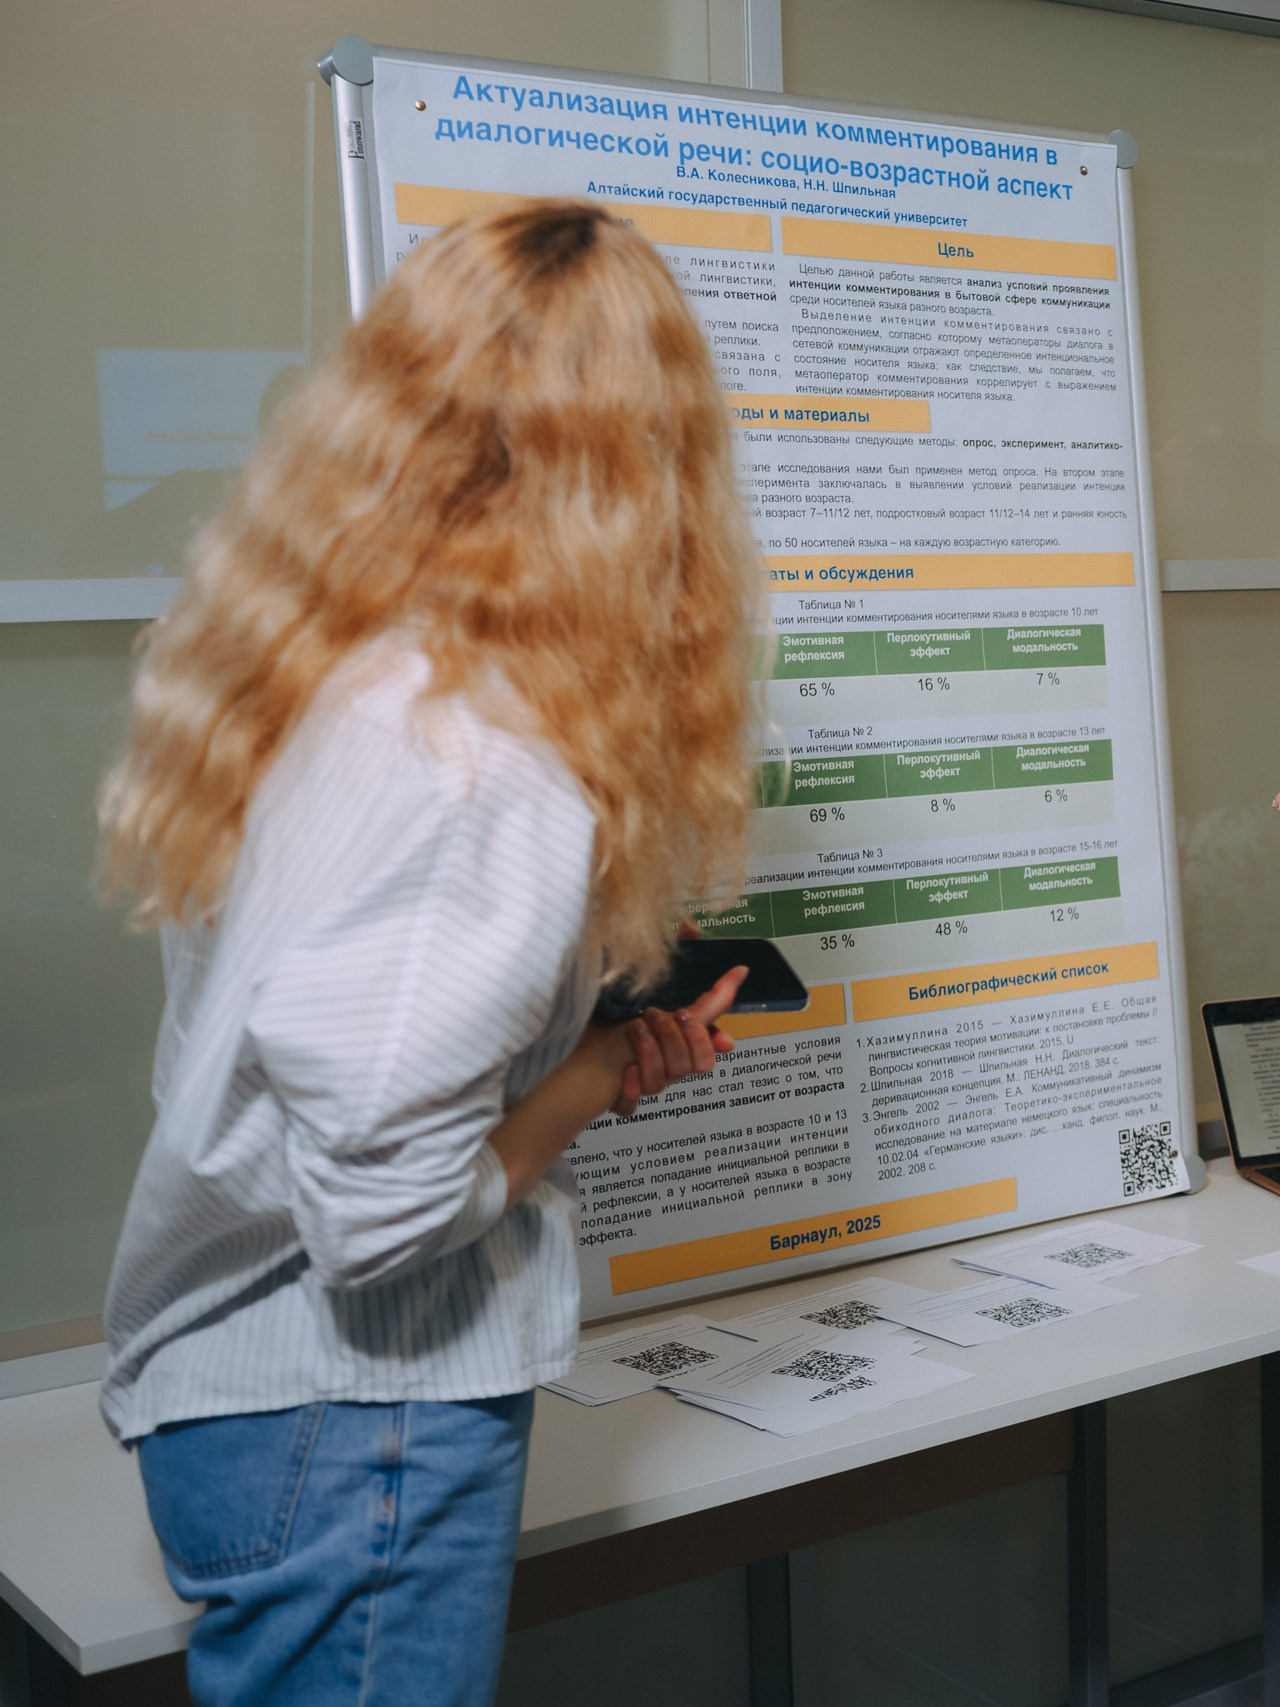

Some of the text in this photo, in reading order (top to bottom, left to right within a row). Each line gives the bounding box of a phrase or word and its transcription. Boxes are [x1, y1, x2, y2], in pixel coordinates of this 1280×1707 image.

[452, 74, 1057, 165] Актуализация интенции комментирования в
[434, 119, 1073, 199] диалогической речи: социо-возрастной аспект
[676, 163, 896, 198] В.А. Колесникова, Н.Н. Шпильная
[586, 181, 967, 226] Алтайский государственный педагогический университет
[937, 242, 974, 258] Цель
[689, 257, 775, 270] лингвистики
[798, 263, 1109, 295] Целью данной работы является анализ условий проявления
[722, 290, 776, 301] ответной
[788, 280, 1110, 308] интенции комментирования в бытовой сфере коммуникации
[788, 294, 820, 305] среди
[822, 297, 876, 308] носителей
[877, 300, 907, 310] языка
[908, 302, 946, 313] разного
[704, 319, 779, 332] путем поиска
[800, 308, 1112, 337] Выделение интенции комментирования связано с
[887, 330, 932, 341] согласно
[937, 333, 982, 345] которому
[987, 336, 1061, 347] метаоператоры
[1066, 340, 1103, 349] диалога
[1107, 342, 1113, 350] в
[773, 353, 781, 362] с
[791, 339, 1114, 363] сетевой коммуникации отражают определенное интенциональное
[792, 354, 846, 365] состояние
[853, 358, 900, 367] носителя
[945, 362, 962, 371] как
[1028, 366, 1042, 374] мы
[1100, 369, 1115, 378] что
[794, 370, 1116, 391] метаоператор комментирования коррелирует с выражением
[794, 384, 843, 395] интенции
[845, 387, 934, 398] комментирования
[936, 391, 982, 400] носителя
[768, 408, 870, 422] и материалы
[776, 434, 850, 444] использованы
[854, 436, 914, 447] следующие
[918, 437, 959, 447] методы:
[961, 438, 996, 448] опрос,
[1000, 440, 1066, 449] эксперимент,
[1070, 441, 1123, 450] аналитико-
[804, 566, 914, 582] и обсуждения
[798, 598, 863, 610] Таблица № 1
[782, 635, 844, 646] Эмотивная
[886, 630, 970, 644] Перлокутивный
[1006, 626, 1081, 640] Диалогическая
[909, 645, 950, 658] эффект
[1011, 642, 1079, 653] модальность
[783, 650, 845, 663] рефлексия
[917, 676, 950, 691] 16 %
[1036, 671, 1060, 685] 7 %
[798, 681, 835, 697] 65 %
[809, 725, 872, 739] Таблица № 2
[818, 847, 883, 863] Таблица № 3
[1022, 858, 1096, 878] Диалогическая
[905, 871, 988, 890] Перлокутивный
[1028, 876, 1093, 890] модальность
[801, 886, 864, 900] Эмотивная
[928, 889, 968, 903] эффект
[803, 901, 865, 918] рефлексия
[1049, 906, 1080, 922] 12 %
[934, 920, 968, 936] 48 %
[819, 933, 855, 950] 35 %
[908, 963, 1108, 1000] Библиографический список
[615, 1081, 845, 1124] комментирования зависит от возраста
[876, 1148, 919, 1165] 10.02.04
[907, 1161, 926, 1175] 208
[580, 1170, 852, 1228] попадание инициальной реплики в зону
[578, 1228, 636, 1245] эффекта.
[769, 1214, 881, 1250] Барнаул, 2025
